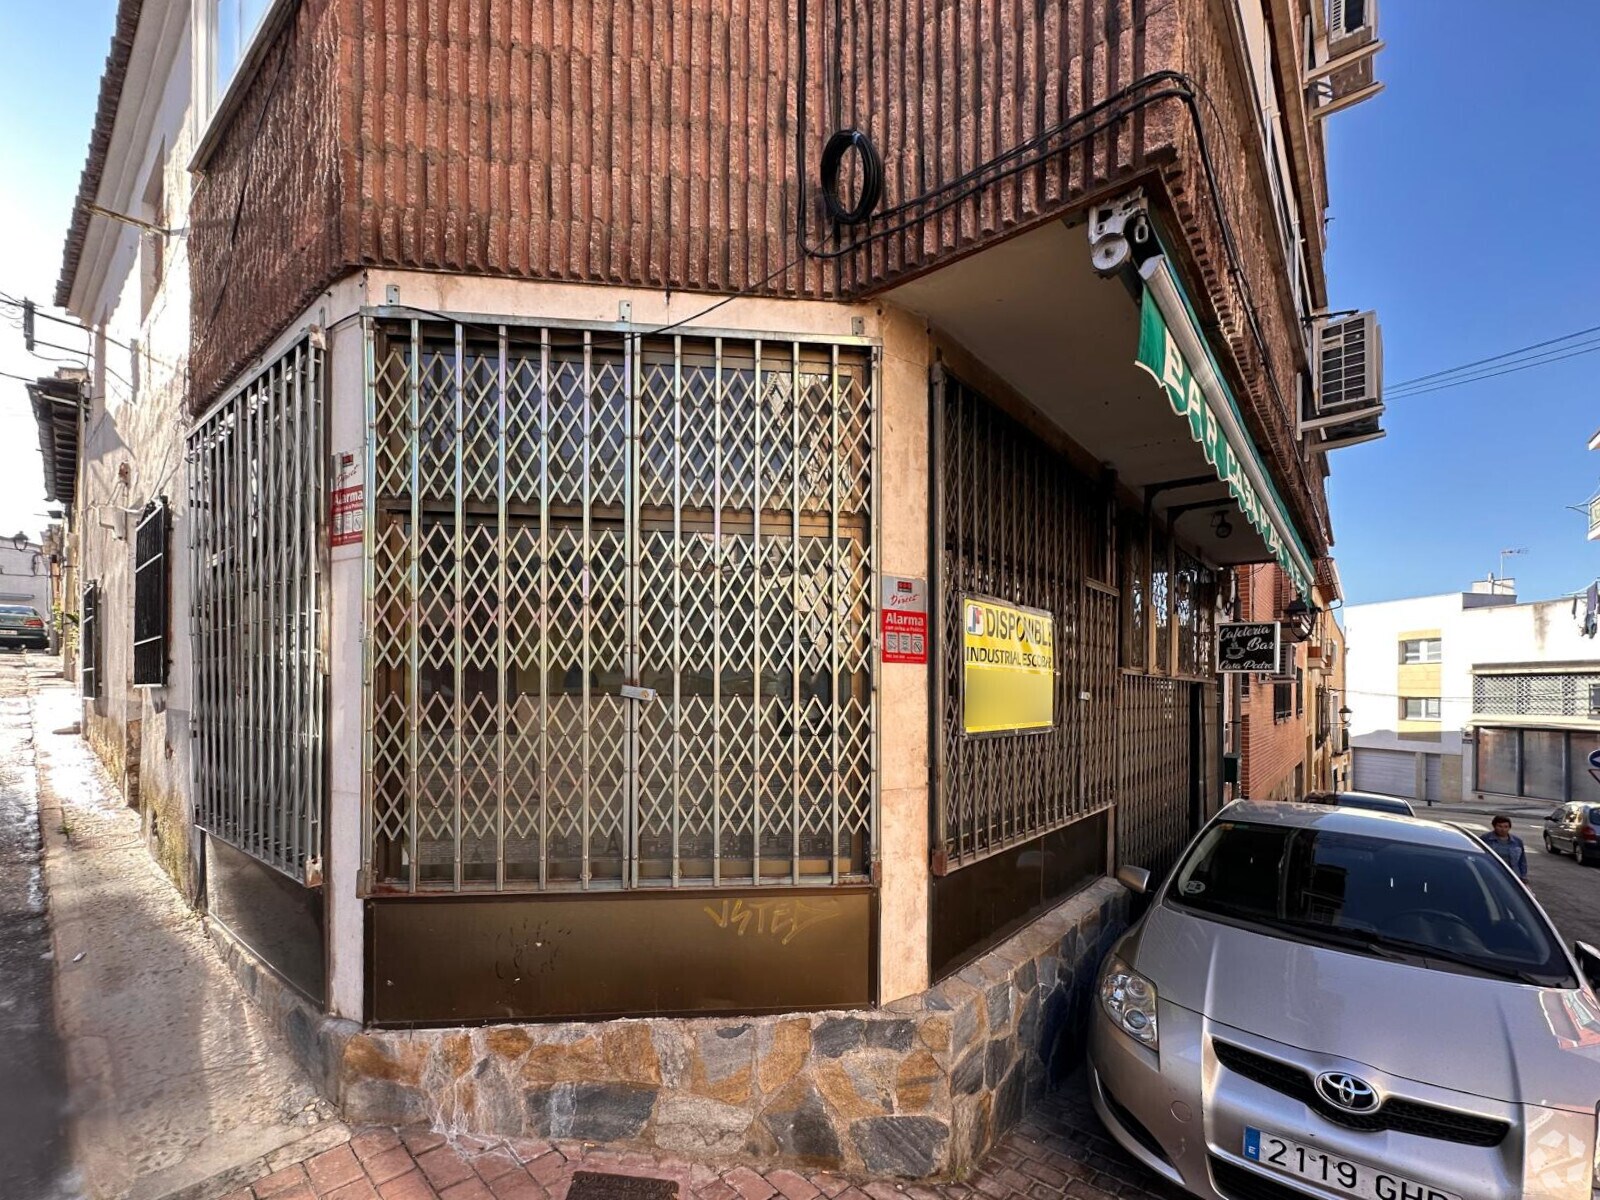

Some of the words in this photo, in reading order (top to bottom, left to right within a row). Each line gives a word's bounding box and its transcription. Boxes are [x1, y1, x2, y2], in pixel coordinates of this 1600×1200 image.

[1163, 326, 1218, 447] BAR
[885, 612, 924, 627] Alarma
[1246, 637, 1274, 651] Bar
[966, 646, 1021, 666] INDUSTRIAL
[1219, 660, 1241, 671] Casa
[1242, 660, 1272, 670] Pedro
[1249, 1146, 1255, 1154] E
[1267, 1139, 1357, 1189] 2119
